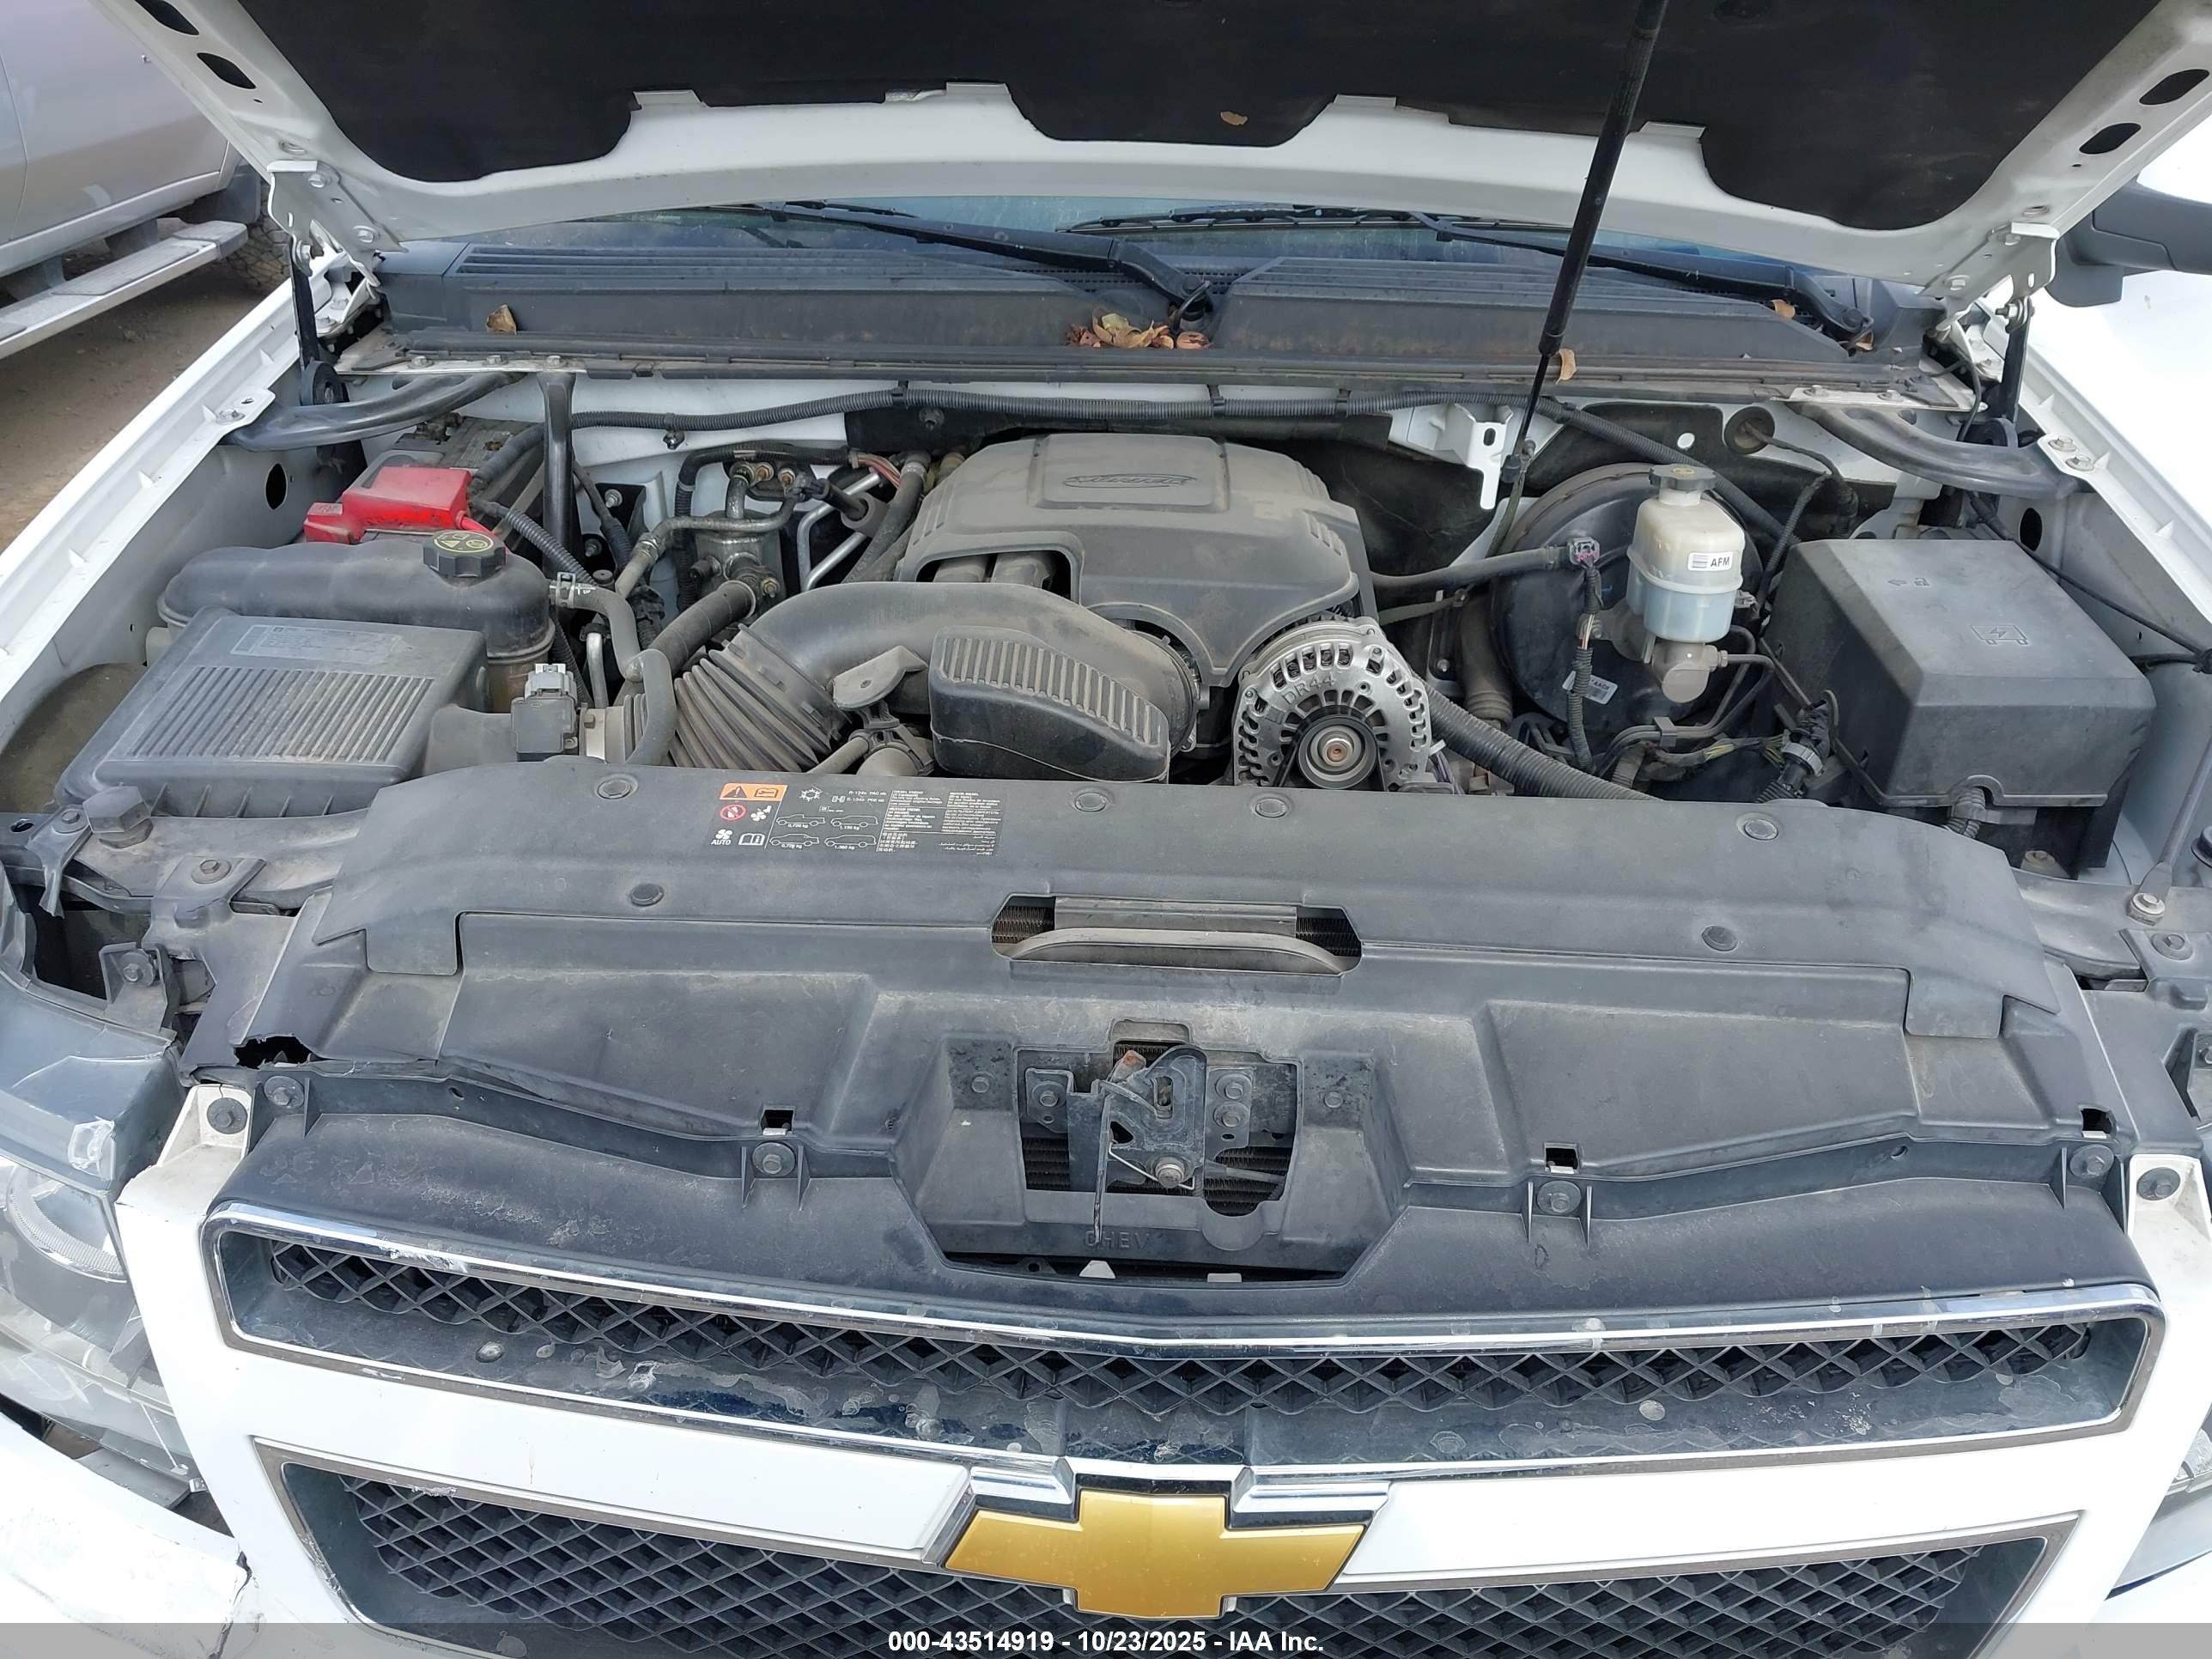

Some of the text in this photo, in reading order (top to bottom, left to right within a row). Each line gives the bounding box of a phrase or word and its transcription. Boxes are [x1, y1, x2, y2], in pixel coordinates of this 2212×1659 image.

[1711, 556, 1730, 568] AFM
[1281, 673, 1336, 704] DR44
[1084, 1230, 1150, 1251] CHEV
